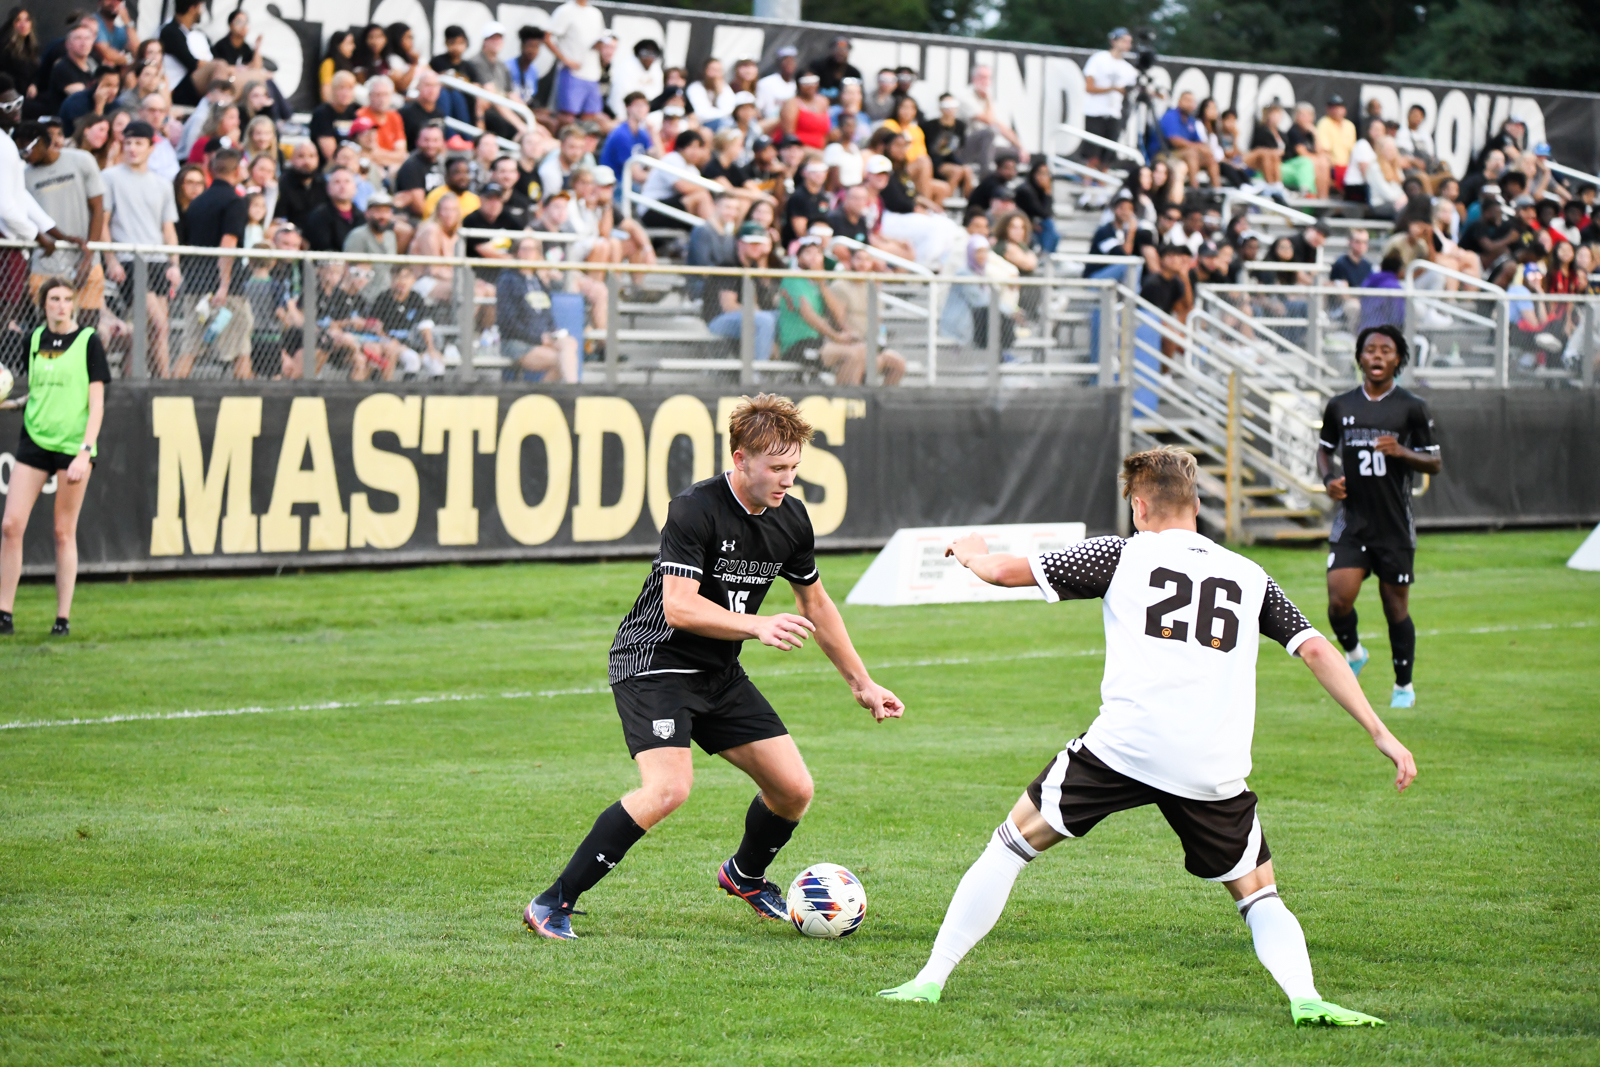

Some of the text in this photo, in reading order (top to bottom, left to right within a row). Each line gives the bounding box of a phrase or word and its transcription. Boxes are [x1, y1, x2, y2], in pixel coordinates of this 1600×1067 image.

[150, 392, 848, 556] MASTODOS
[1358, 449, 1387, 477] 20
[714, 557, 783, 577] PURDUE
[721, 572, 743, 584] FORT
[1144, 566, 1243, 653] 26
